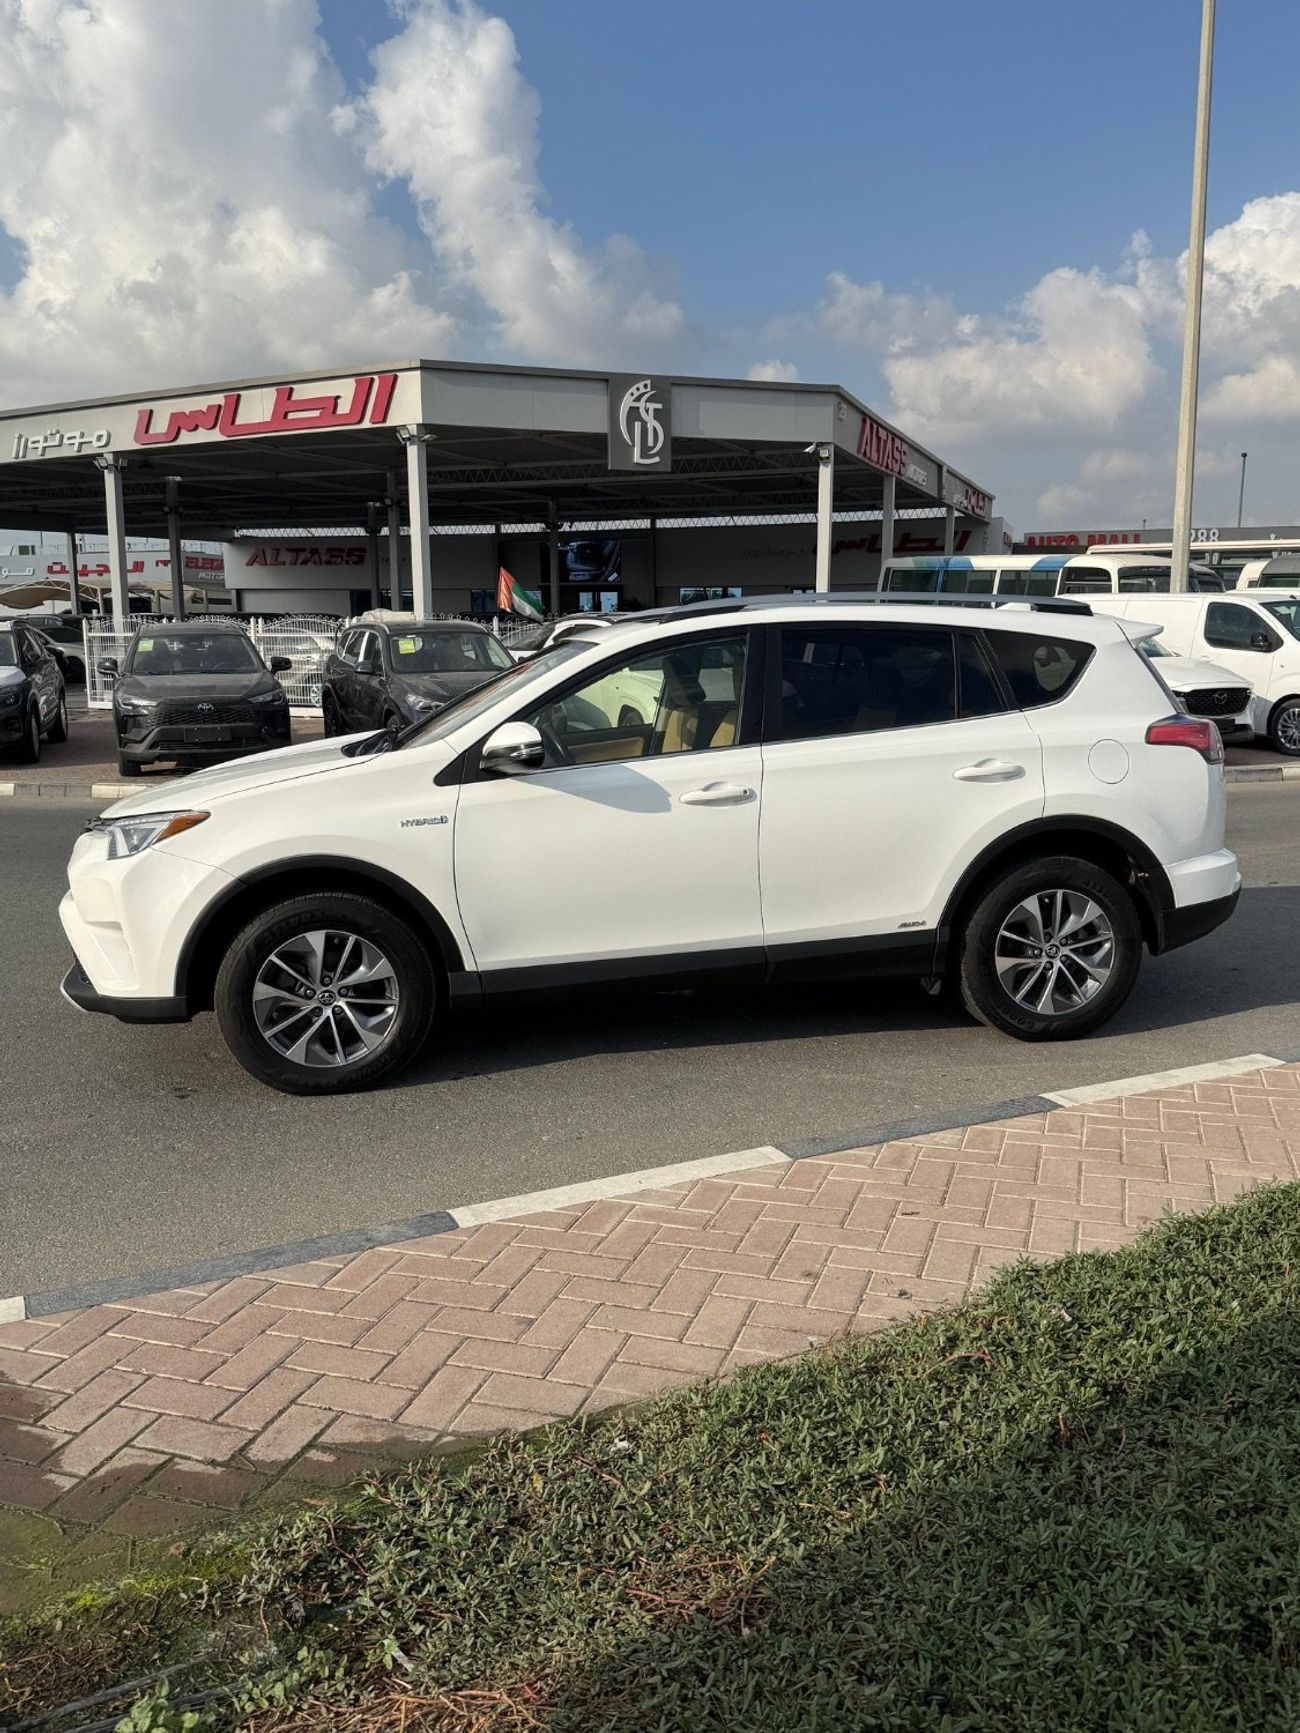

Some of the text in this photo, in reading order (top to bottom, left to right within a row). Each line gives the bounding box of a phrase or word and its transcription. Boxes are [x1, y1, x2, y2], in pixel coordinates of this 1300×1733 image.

[133, 373, 398, 446] الطاس
[857, 416, 906, 477] ALTASS
[1026, 534, 1080, 547] AUTO
[198, 571, 226, 580] MOTOR
